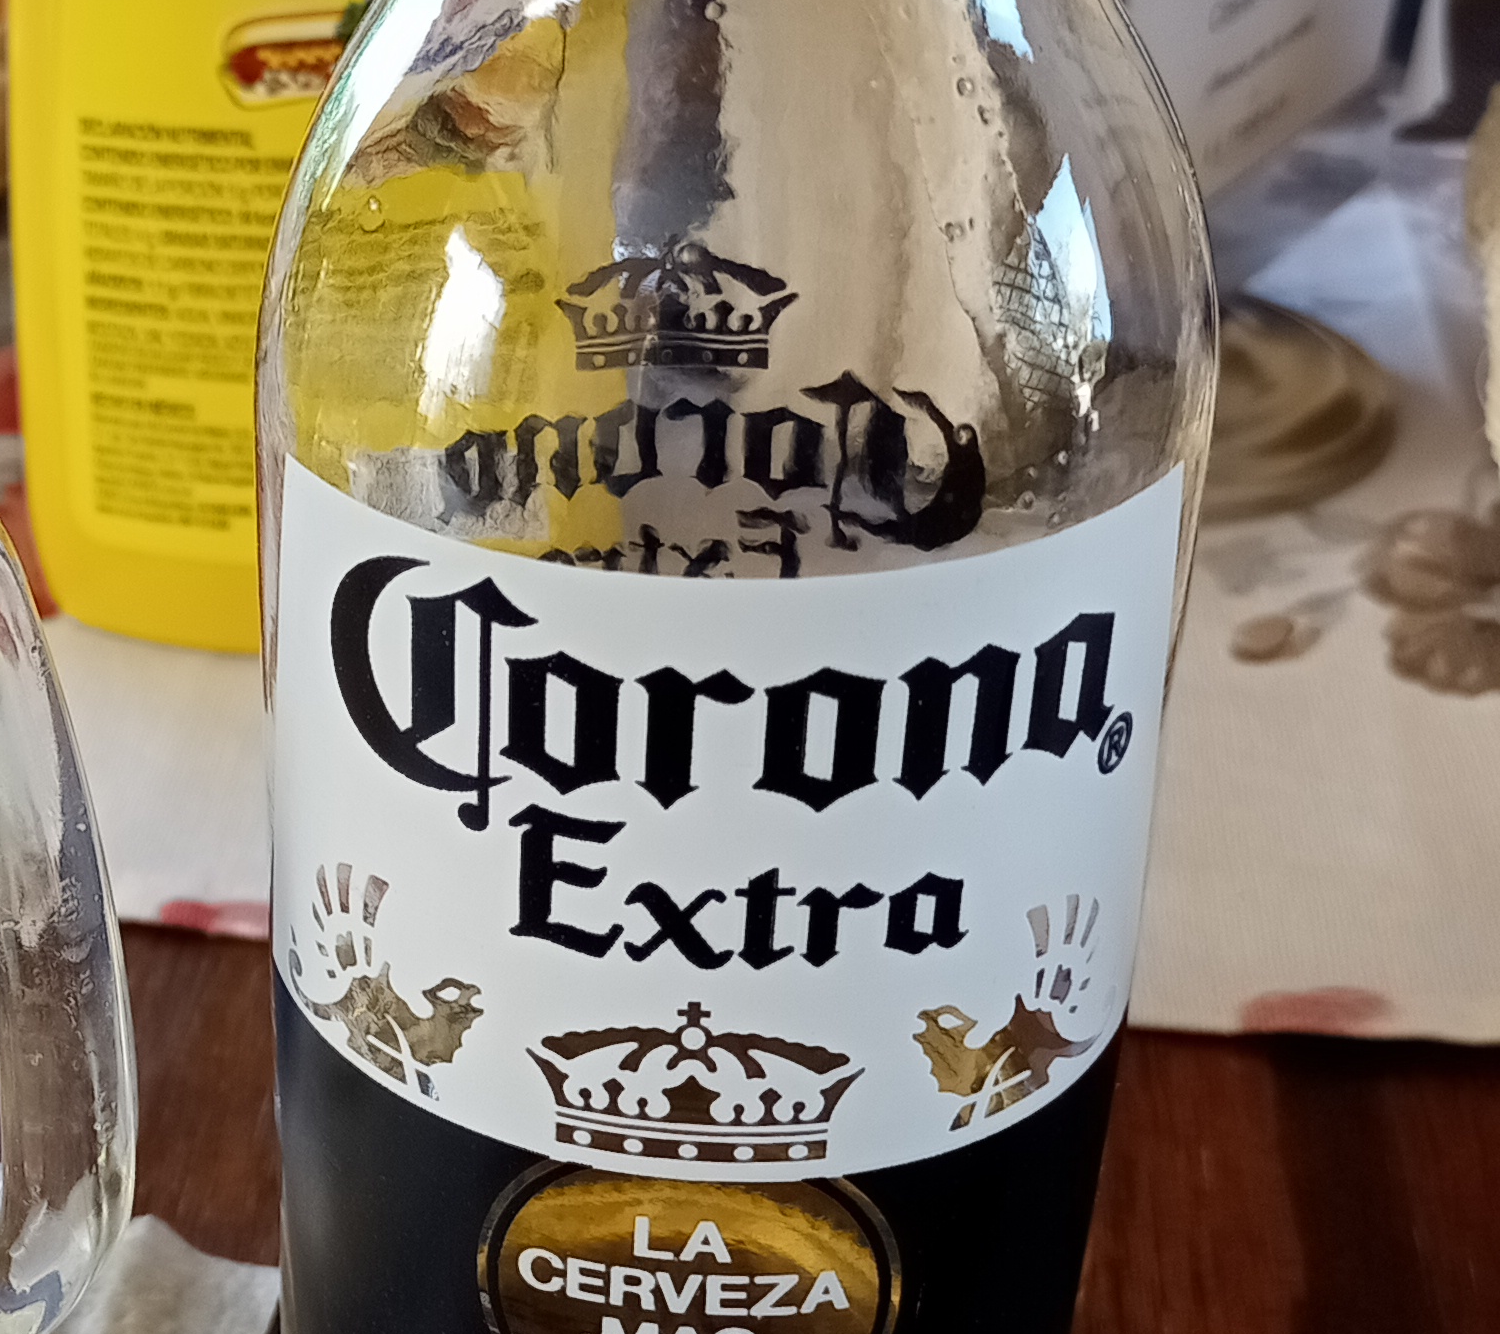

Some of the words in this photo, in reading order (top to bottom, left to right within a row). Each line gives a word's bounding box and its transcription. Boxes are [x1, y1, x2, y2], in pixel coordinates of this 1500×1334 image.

[330, 555, 1116, 831] Corona
[508, 803, 970, 970] Extra
[517, 1247, 850, 1317] CERVEZA
[632, 1215, 732, 1264] LA
